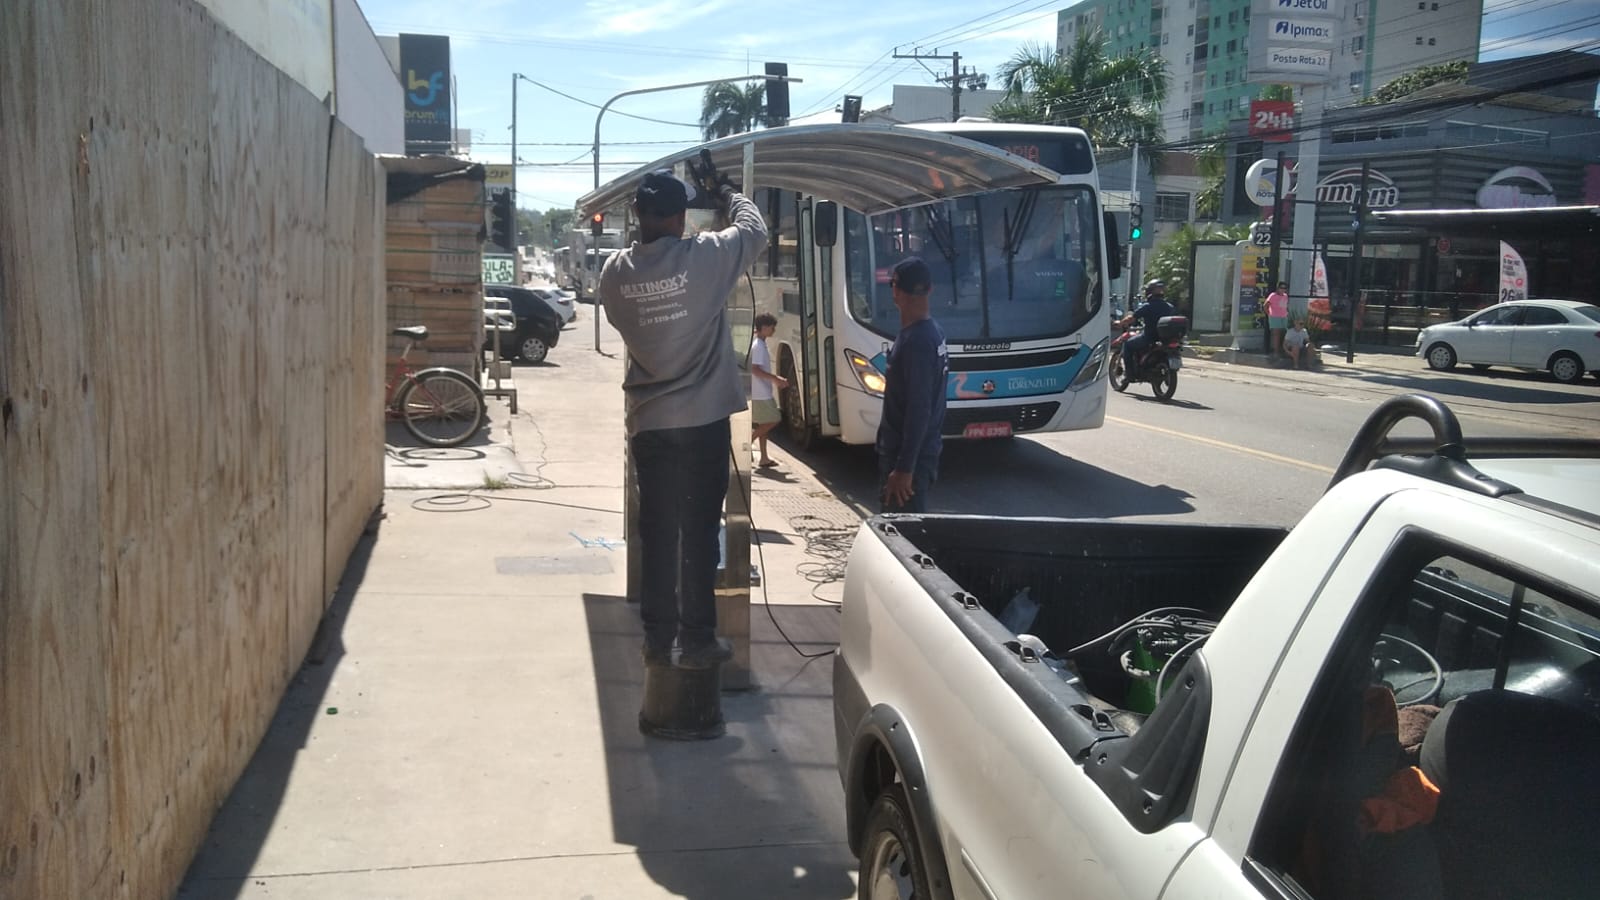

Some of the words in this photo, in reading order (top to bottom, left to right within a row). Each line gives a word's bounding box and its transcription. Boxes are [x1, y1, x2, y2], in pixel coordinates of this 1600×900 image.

[1291, 23, 1328, 38] Ipimax
[1273, 54, 1297, 63] Posto
[1299, 56, 1316, 65] Rota
[1255, 111, 1294, 129] 24h
[1256, 233, 1272, 245] 22
